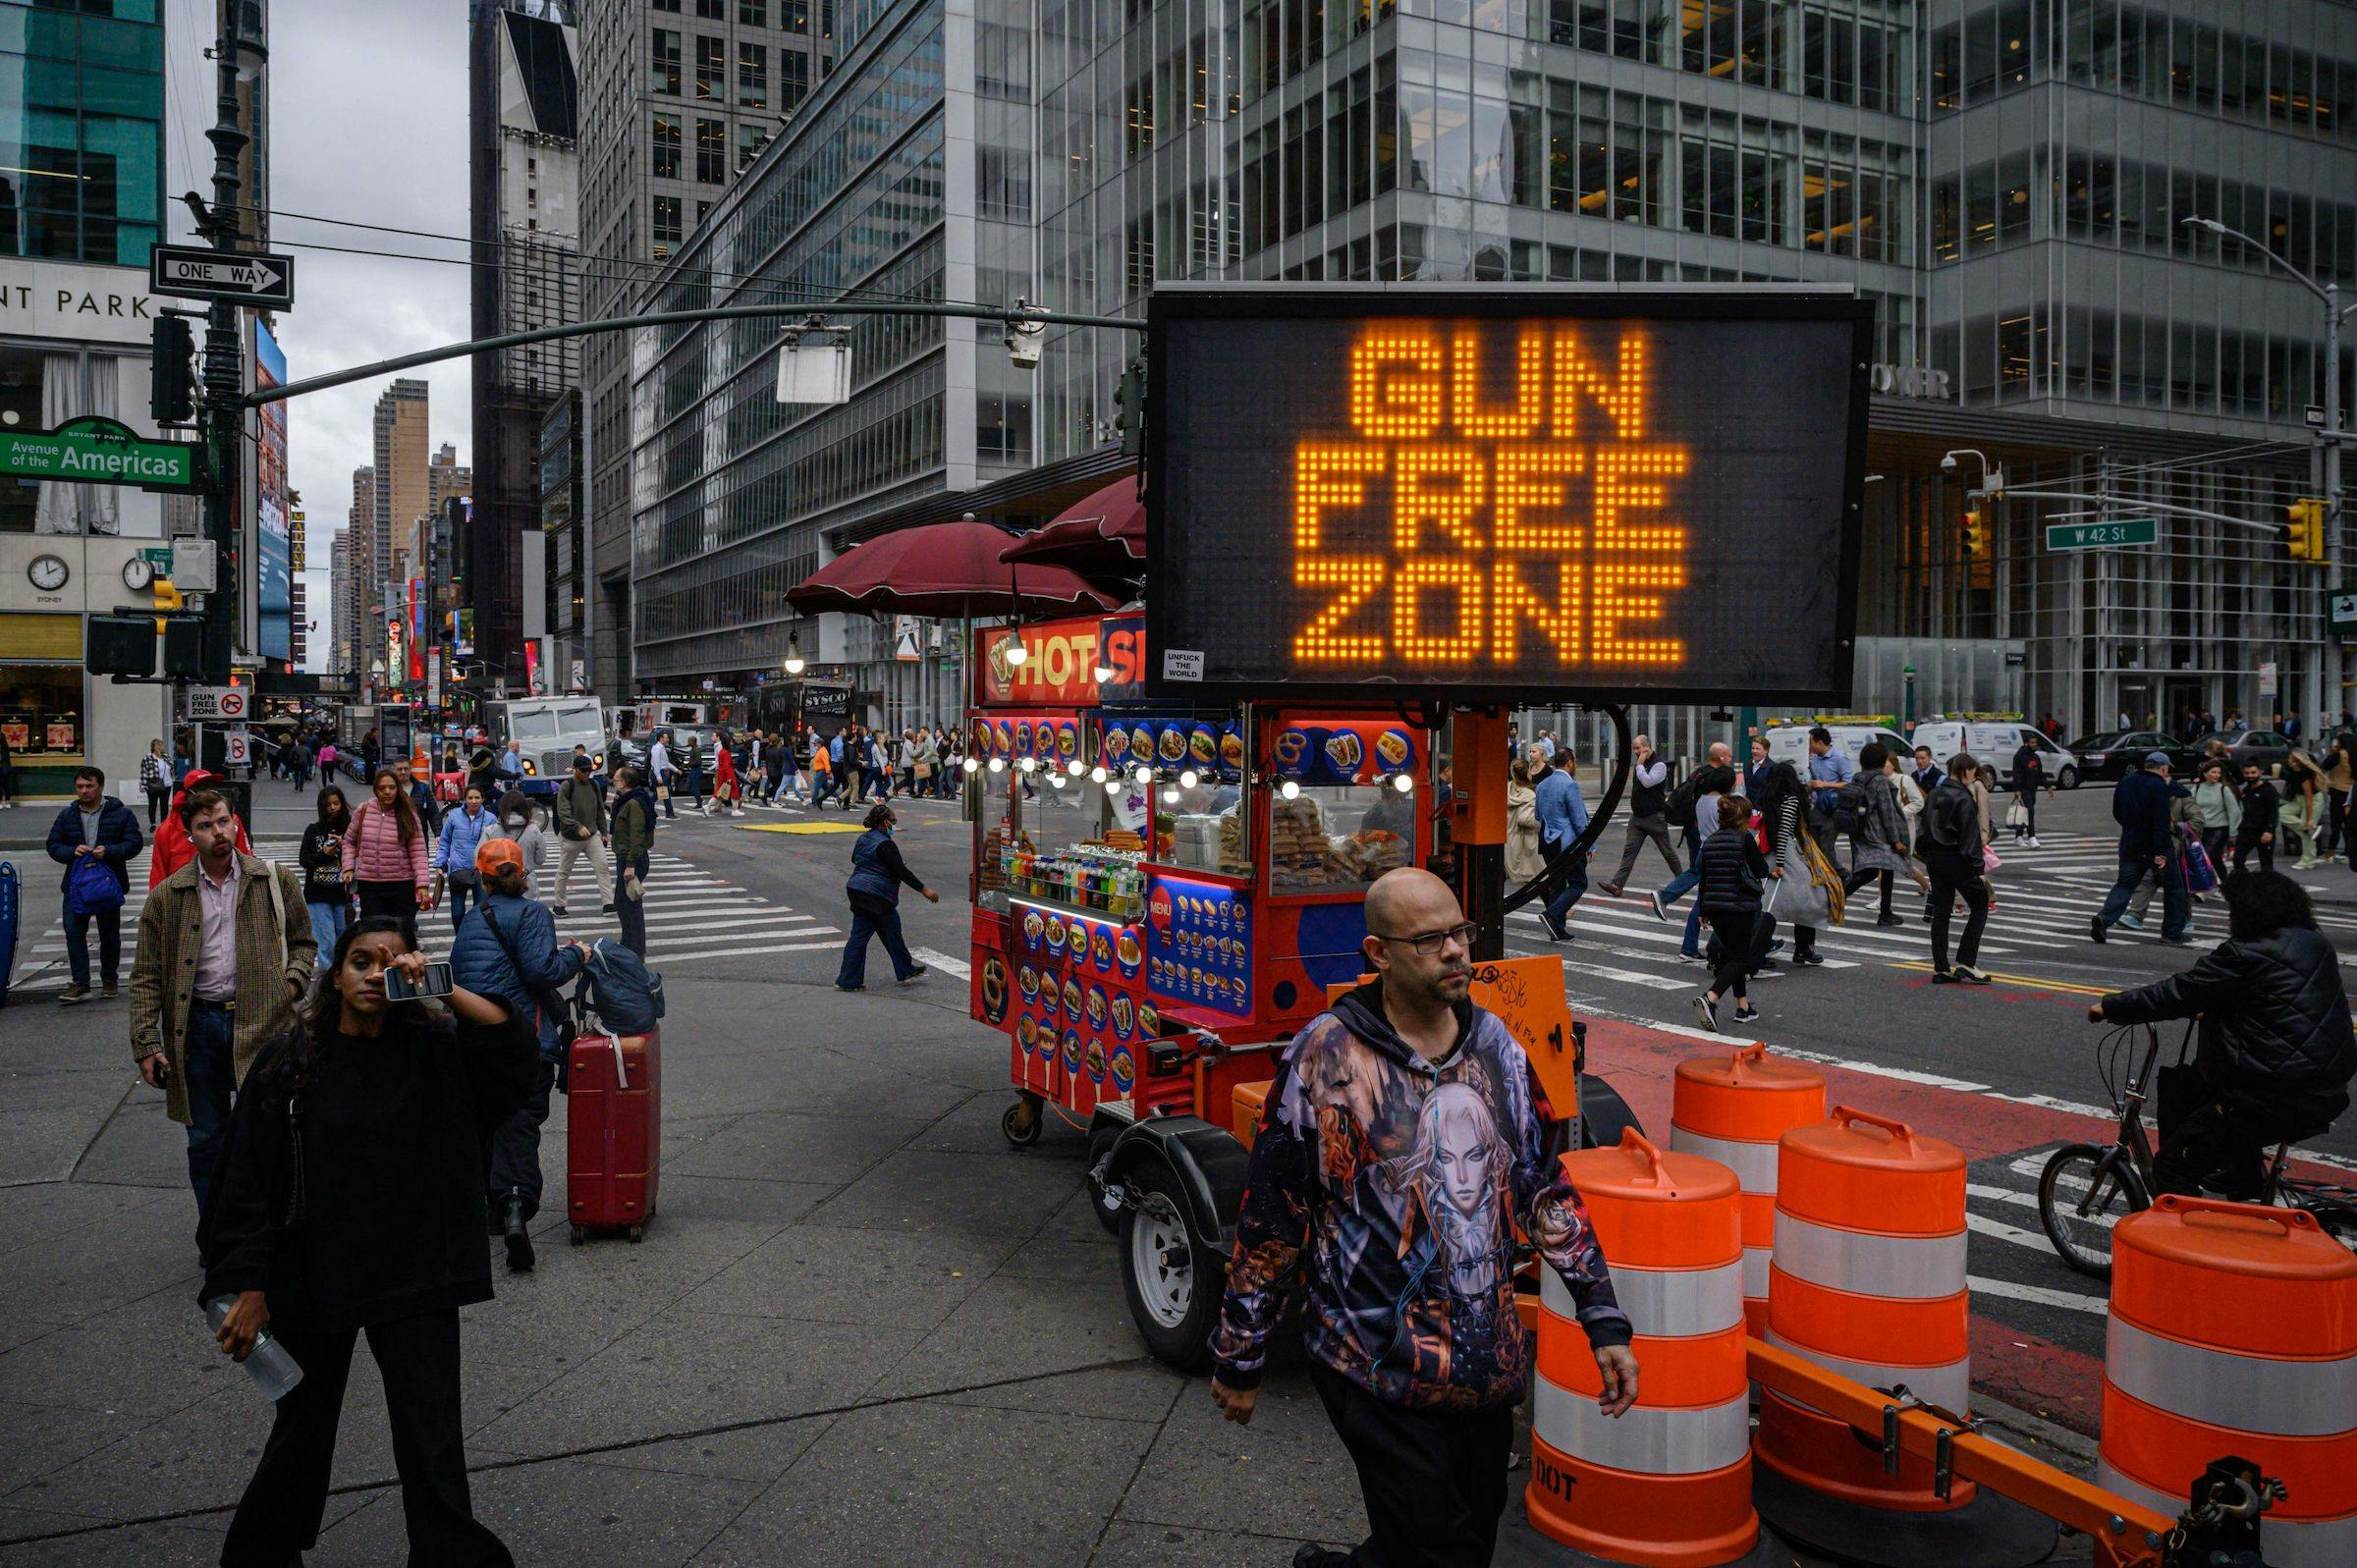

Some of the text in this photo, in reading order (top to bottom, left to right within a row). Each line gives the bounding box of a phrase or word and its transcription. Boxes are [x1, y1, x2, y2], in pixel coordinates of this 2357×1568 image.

[179, 263, 269, 285] ONE WAY
[58, 290, 150, 319] PARK
[1351, 334, 1646, 438] GUN
[12, 441, 59, 456] Avenue
[12, 455, 49, 468] of the
[61, 446, 180, 477] Americas
[1295, 449, 1686, 550] FREE
[2075, 526, 2126, 544] W 42 St
[1294, 561, 1683, 662] ZONE
[1018, 634, 1096, 686] HOT
[805, 692, 846, 707] SYSCO
[1150, 901, 1172, 916] MENU
[1536, 1455, 1577, 1502] DOT
